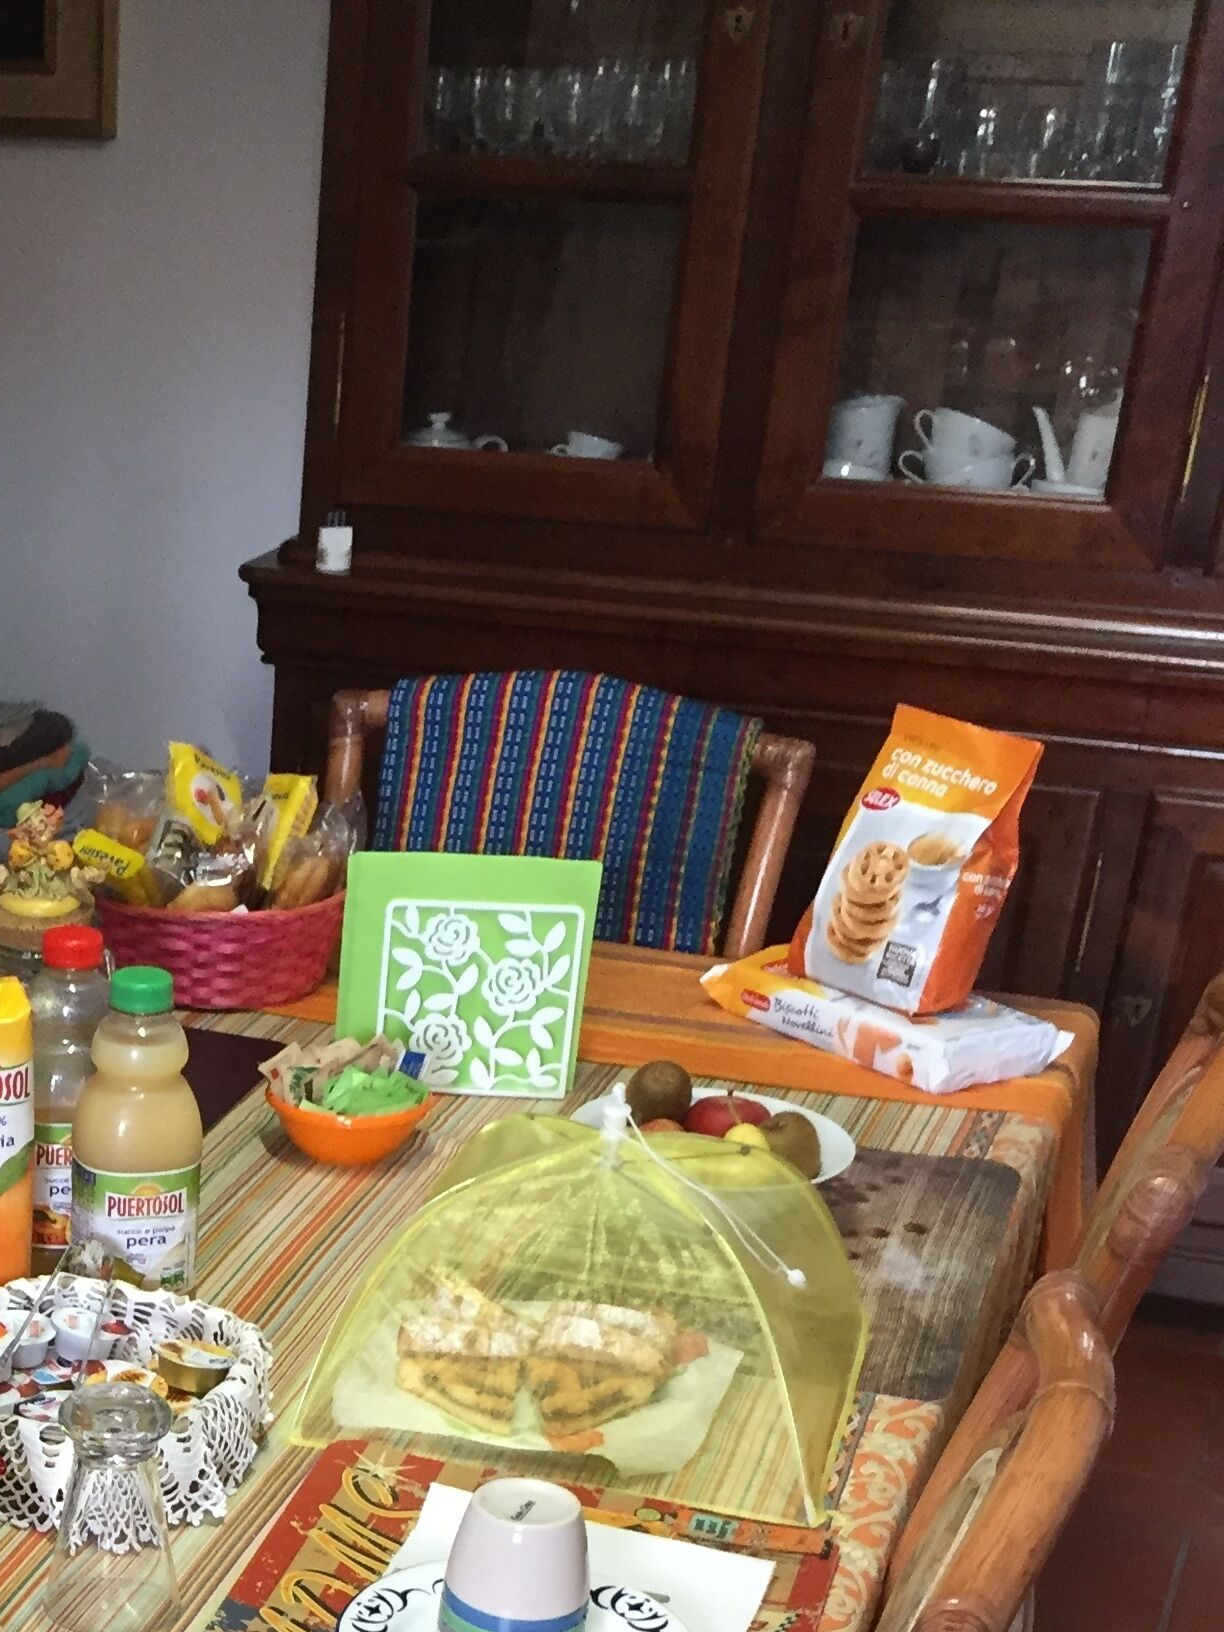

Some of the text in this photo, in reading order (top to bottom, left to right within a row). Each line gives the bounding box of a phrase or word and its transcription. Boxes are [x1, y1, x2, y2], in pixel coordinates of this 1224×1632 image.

[882, 762, 948, 798] di canna
[891, 748, 997, 795] con zucchero
[774, 996, 819, 1018] Biscotti
[782, 1015, 834, 1038] Novellini
[107, 1192, 184, 1217] PUERTOSOL
[126, 1234, 167, 1249] pera
